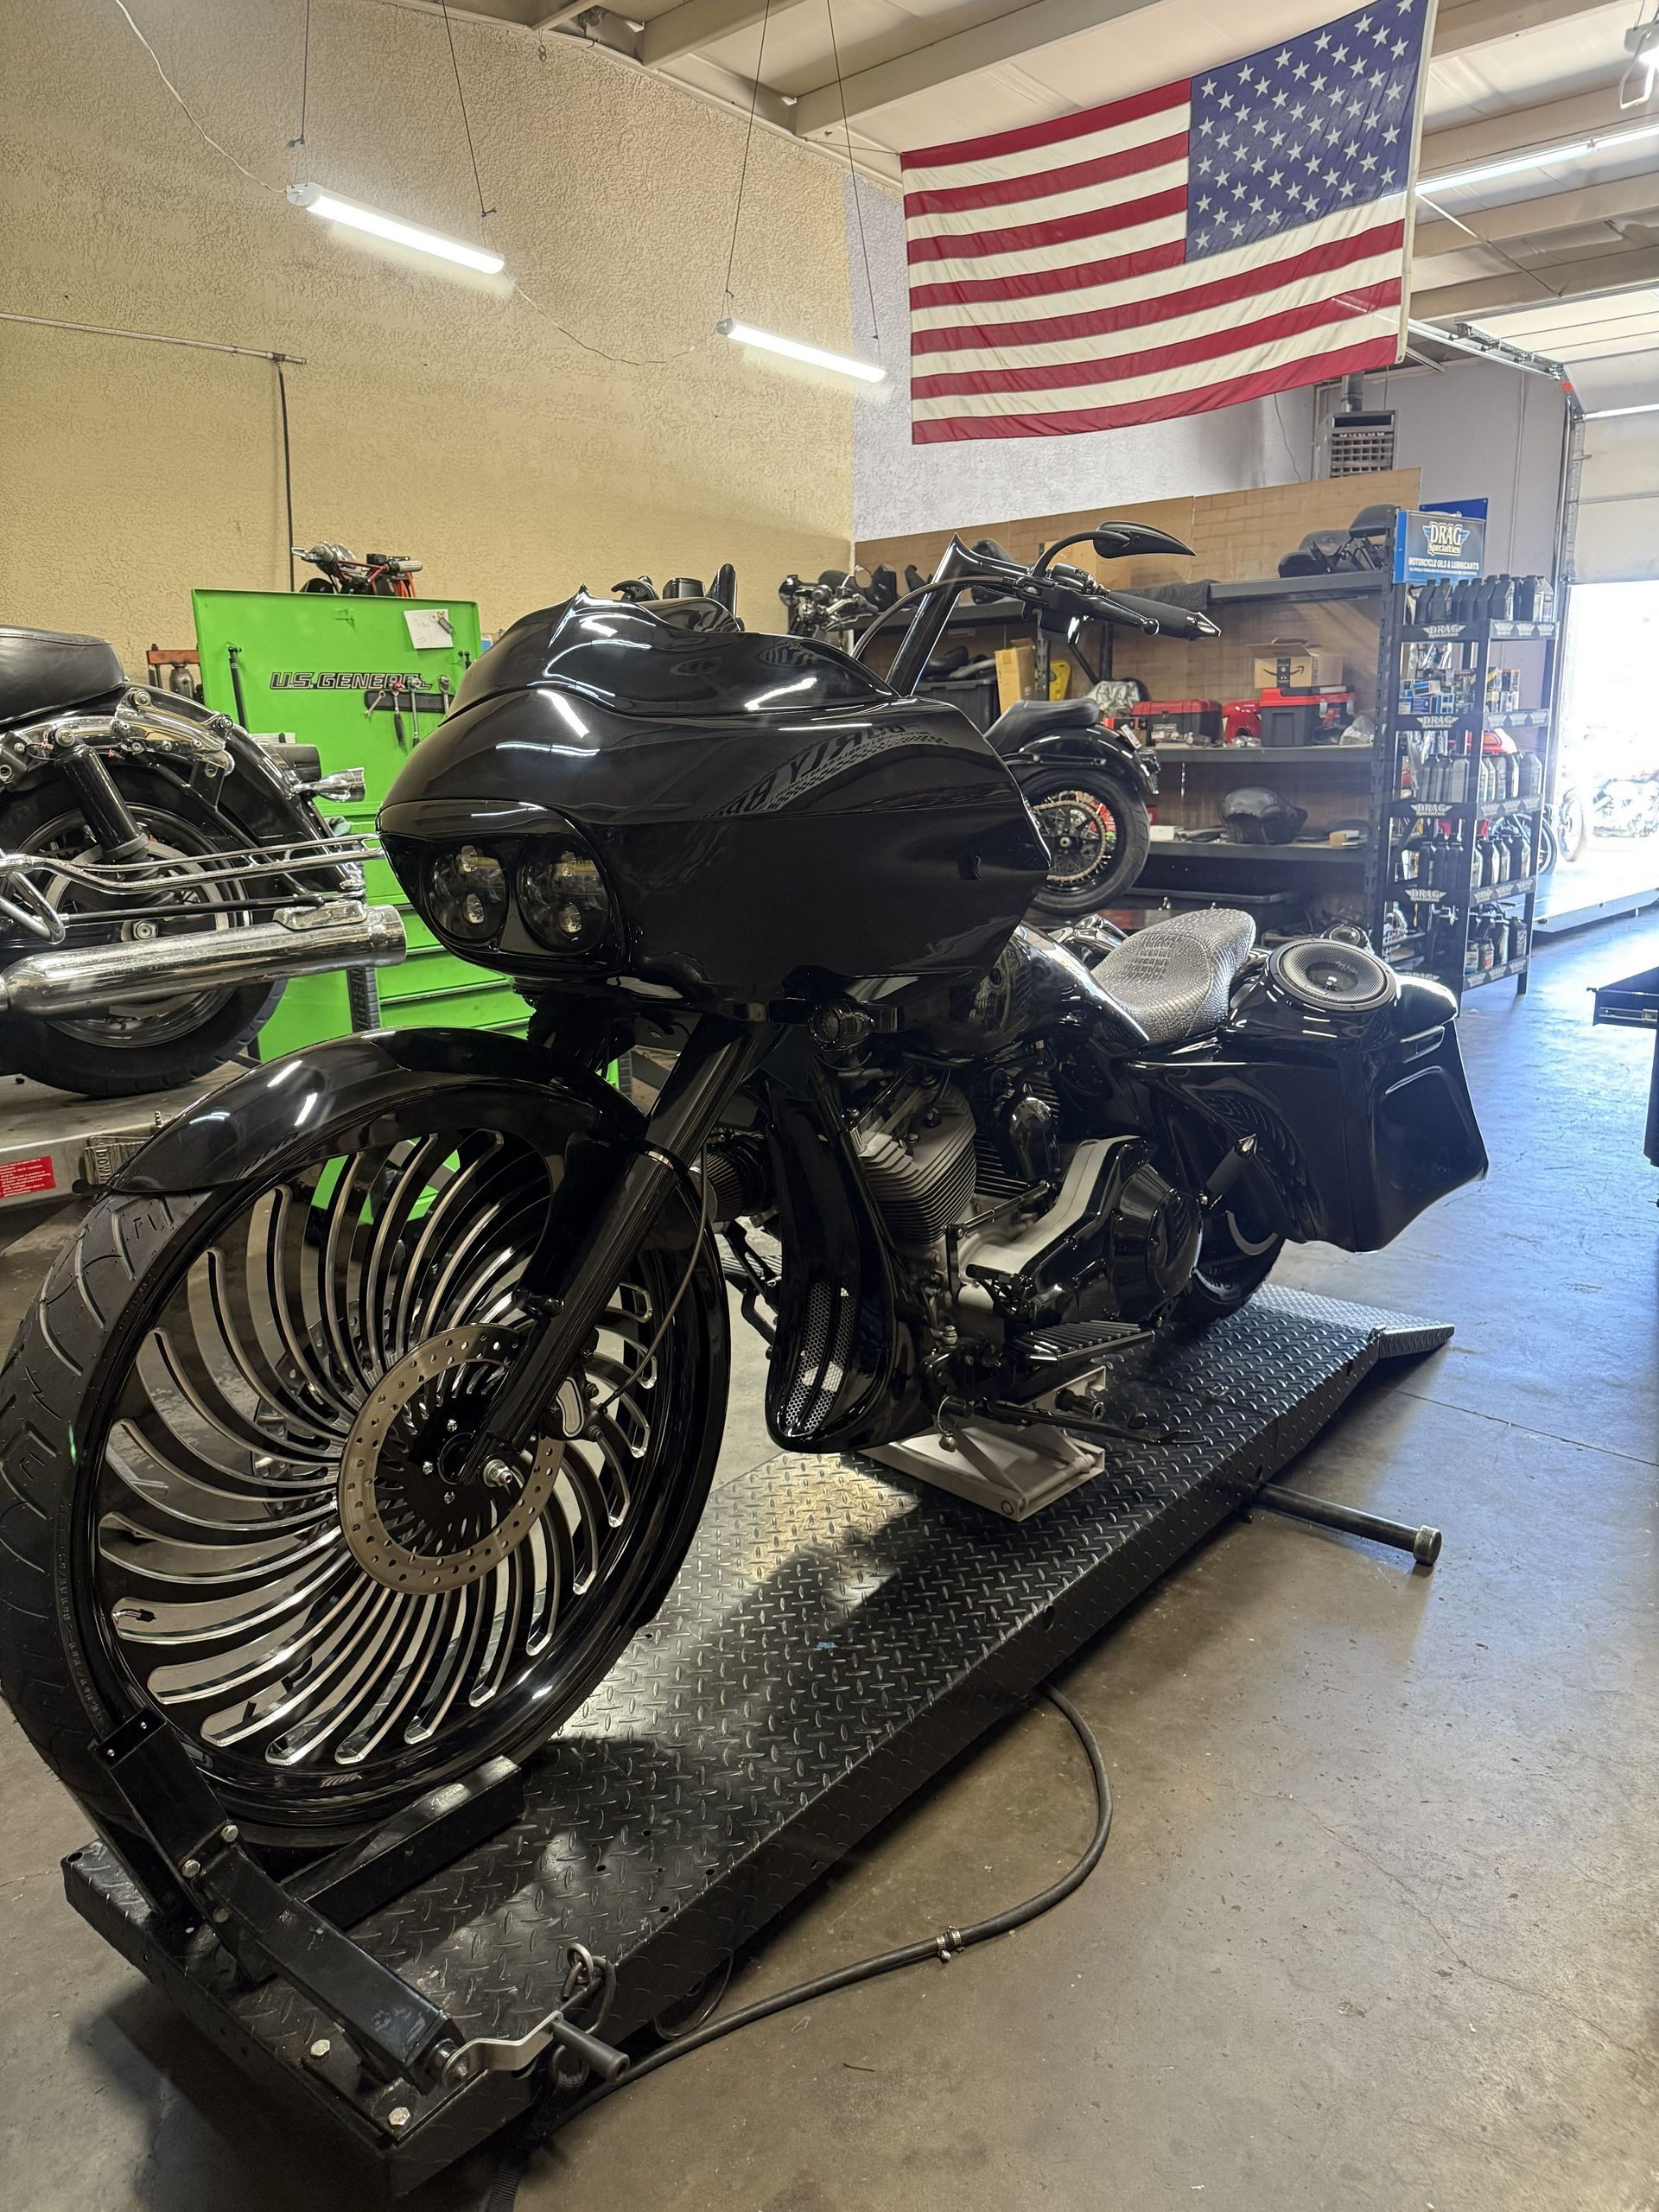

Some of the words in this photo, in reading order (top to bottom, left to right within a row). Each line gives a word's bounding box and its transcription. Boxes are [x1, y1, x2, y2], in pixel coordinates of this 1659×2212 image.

[1430, 523, 1462, 546] DRAG
[1428, 543, 1460, 554] Specialties
[1408, 557, 1436, 568] MOTORCYCLE
[1437, 559, 1446, 569] OILS
[1452, 560, 1479, 570] LUBRICANTS
[1429, 625, 1459, 634] DRAG
[270, 672, 314, 690] U.S.
[1423, 715, 1452, 725] DRAG
[1417, 804, 1446, 813] DRAG
[1411, 889, 1440, 899] DRAG
[95, 1149, 111, 1181] DOWN
